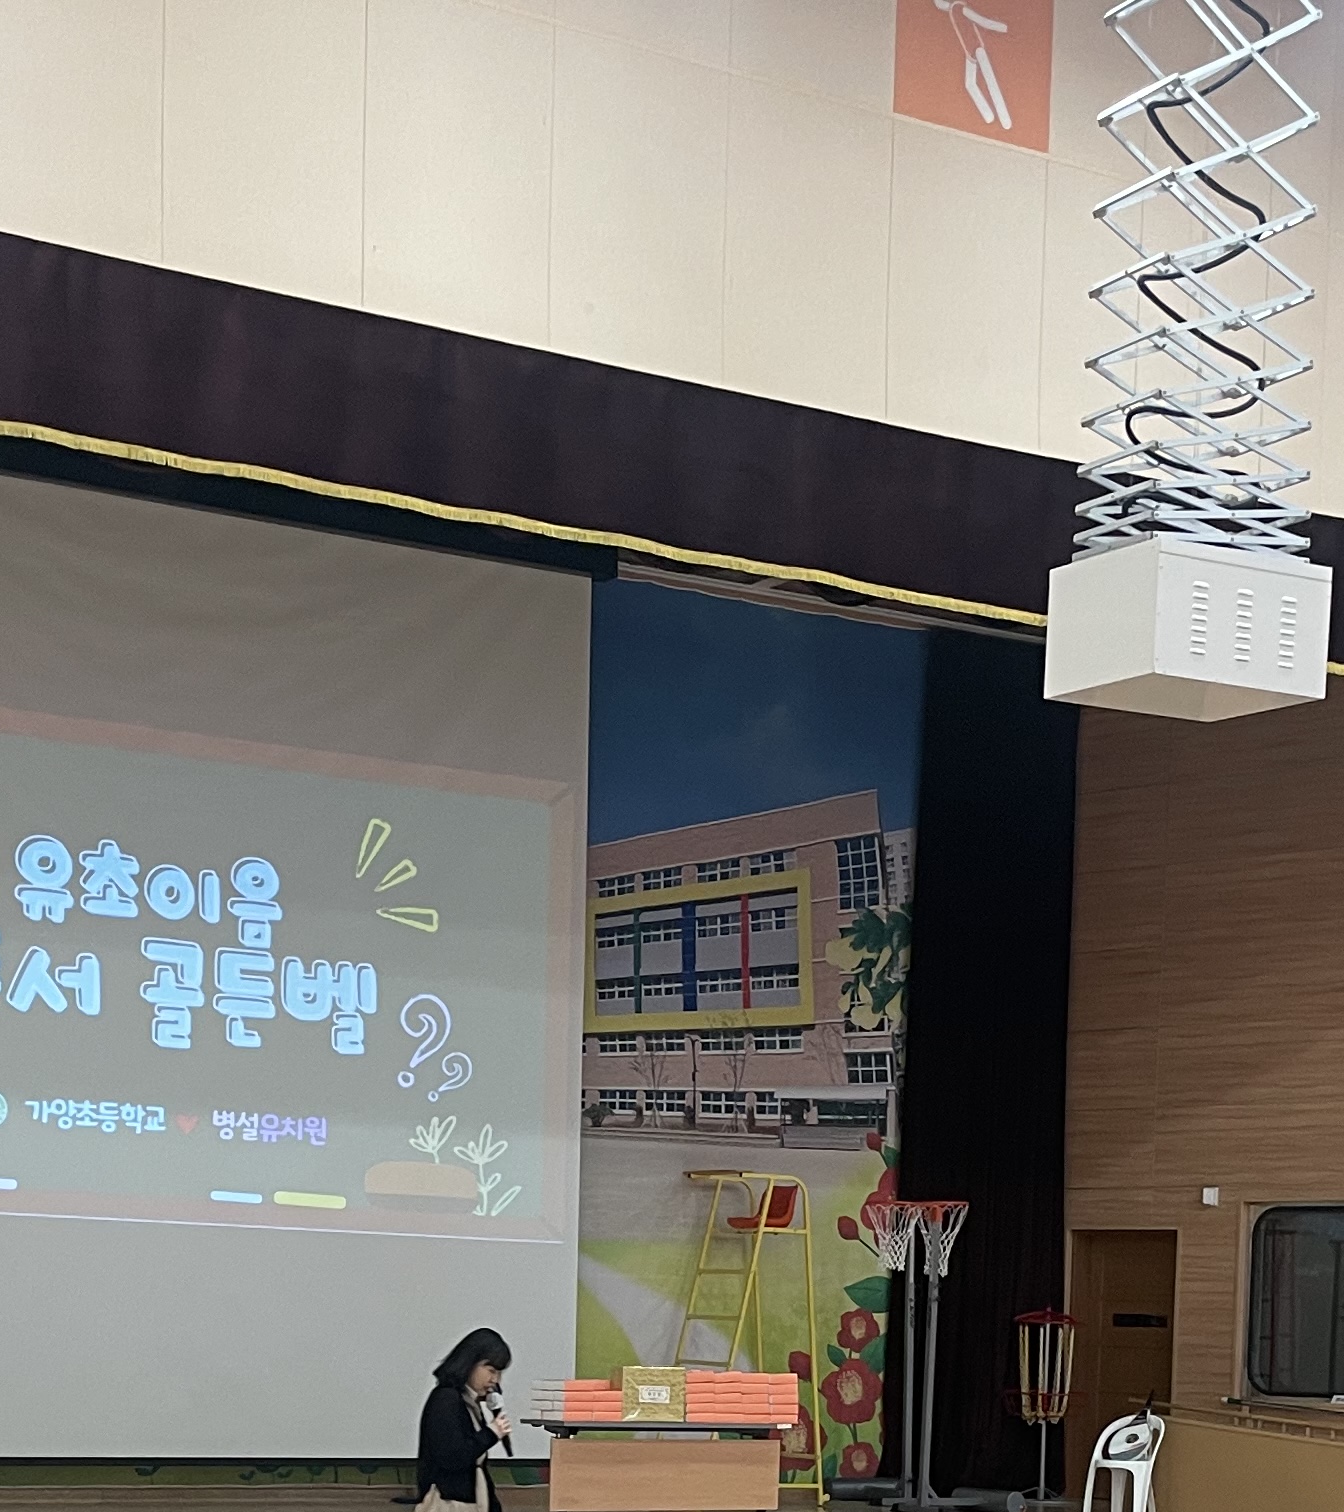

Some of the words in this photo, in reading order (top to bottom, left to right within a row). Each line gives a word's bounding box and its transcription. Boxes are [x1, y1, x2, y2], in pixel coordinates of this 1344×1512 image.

[14, 834, 283, 949] 유초이음
[139, 936, 377, 1055] 골든벨
[24, 1098, 167, 1135] 가양초등학교
[212, 1109, 329, 1146] 병설유치원
